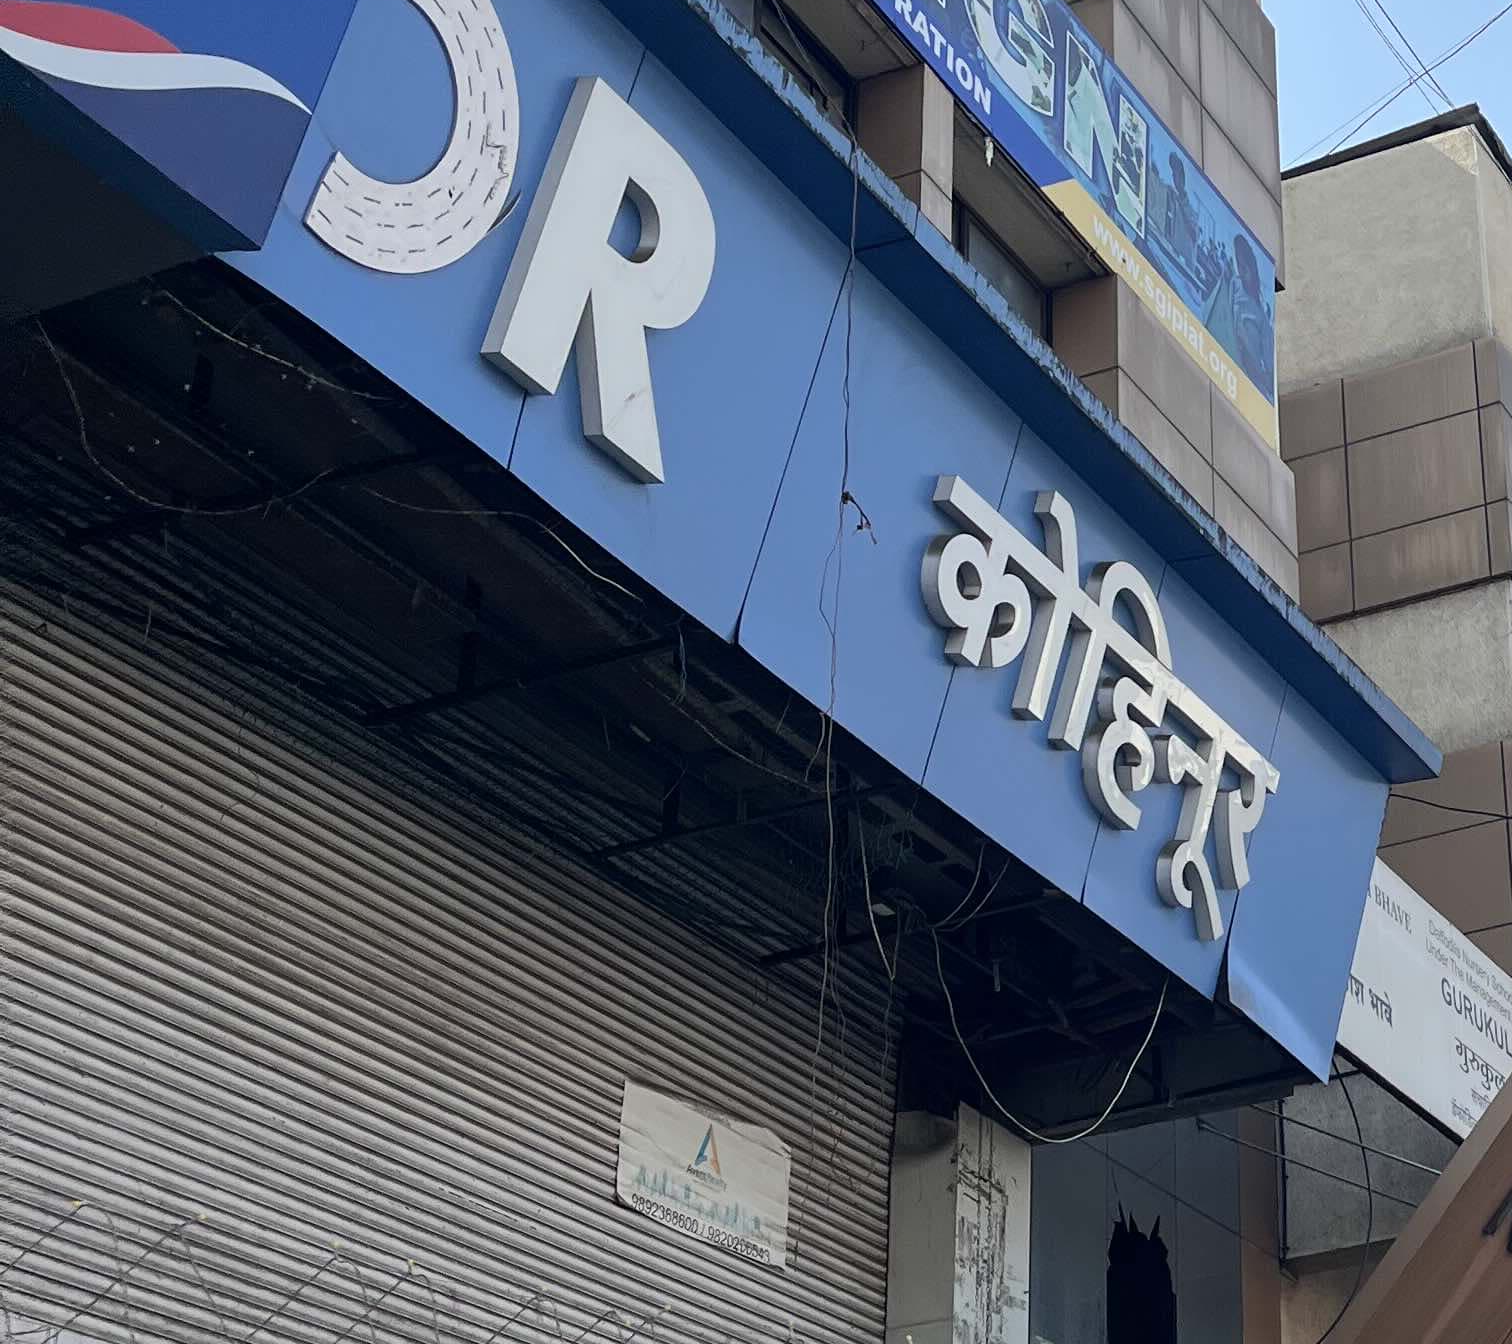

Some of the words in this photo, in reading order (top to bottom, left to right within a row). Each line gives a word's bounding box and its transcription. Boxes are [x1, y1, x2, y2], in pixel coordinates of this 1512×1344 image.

[920, 473, 1280, 942] कोहिनूर
[1373, 884, 1413, 935] BHAVE
[1424, 937, 1449, 969] Under
